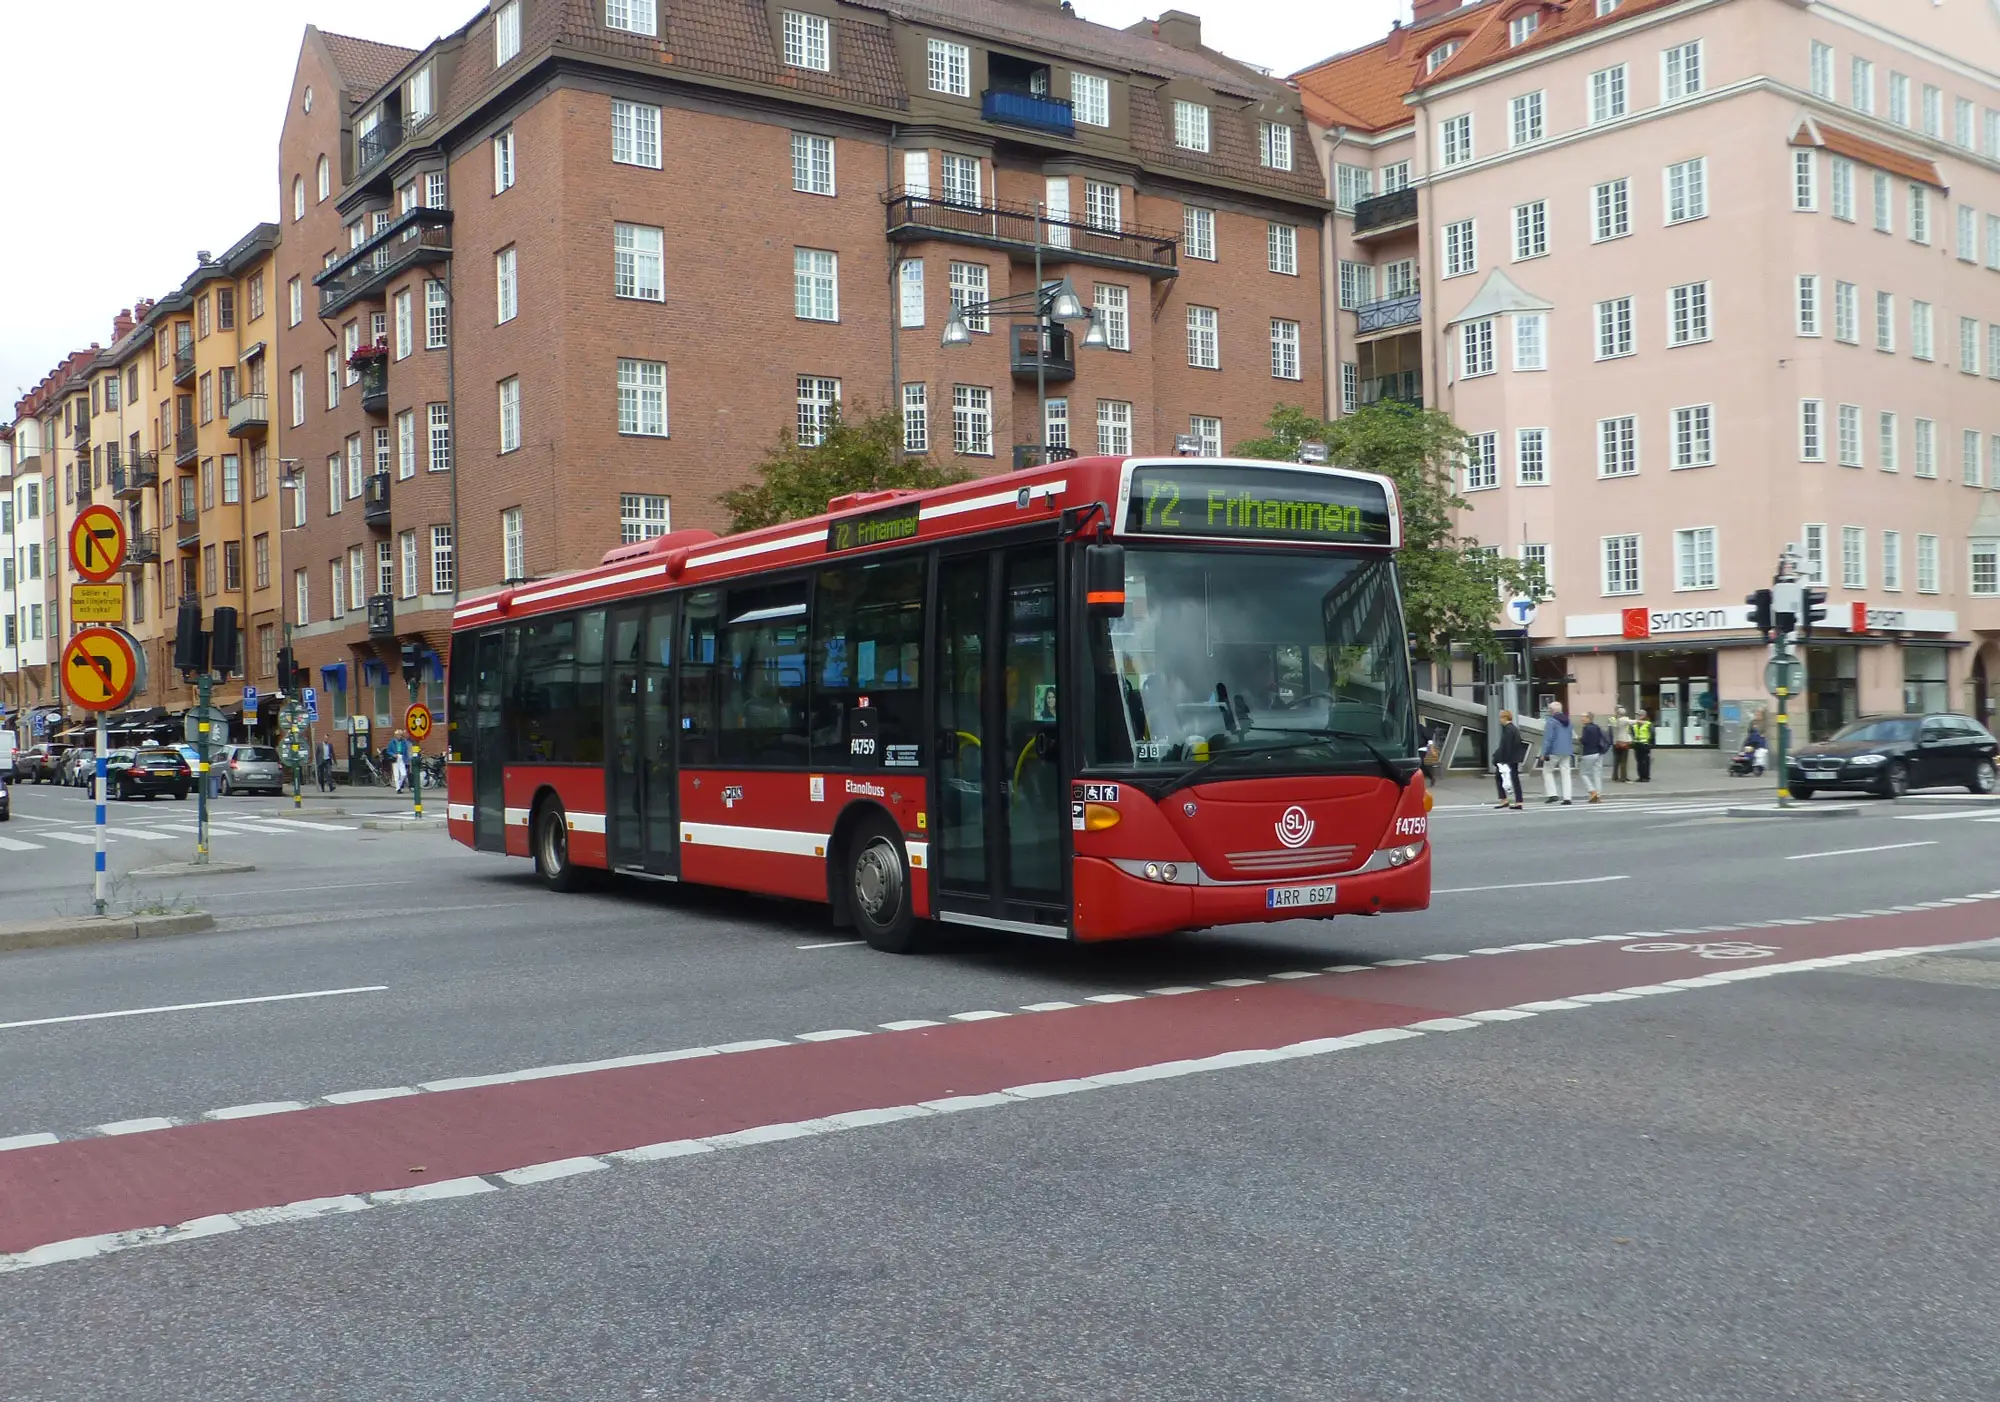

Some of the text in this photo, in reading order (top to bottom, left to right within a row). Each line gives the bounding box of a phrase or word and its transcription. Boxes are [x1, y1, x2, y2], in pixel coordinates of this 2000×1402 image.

[1142, 480, 1360, 533] 72 Frihamnen
[836, 523, 849, 550] 72
[1512, 602, 1532, 621] T
[1651, 610, 1725, 630] SYNSAM
[247, 688, 254, 698] P
[305, 689, 313, 700] P
[410, 713, 428, 731] 30
[851, 739, 875, 755] f4759
[845, 779, 885, 797] Etanolbuss
[1286, 814, 1303, 830] SL
[1395, 817, 1426, 836] f4759
[1275, 887, 1333, 905] ARR 697
